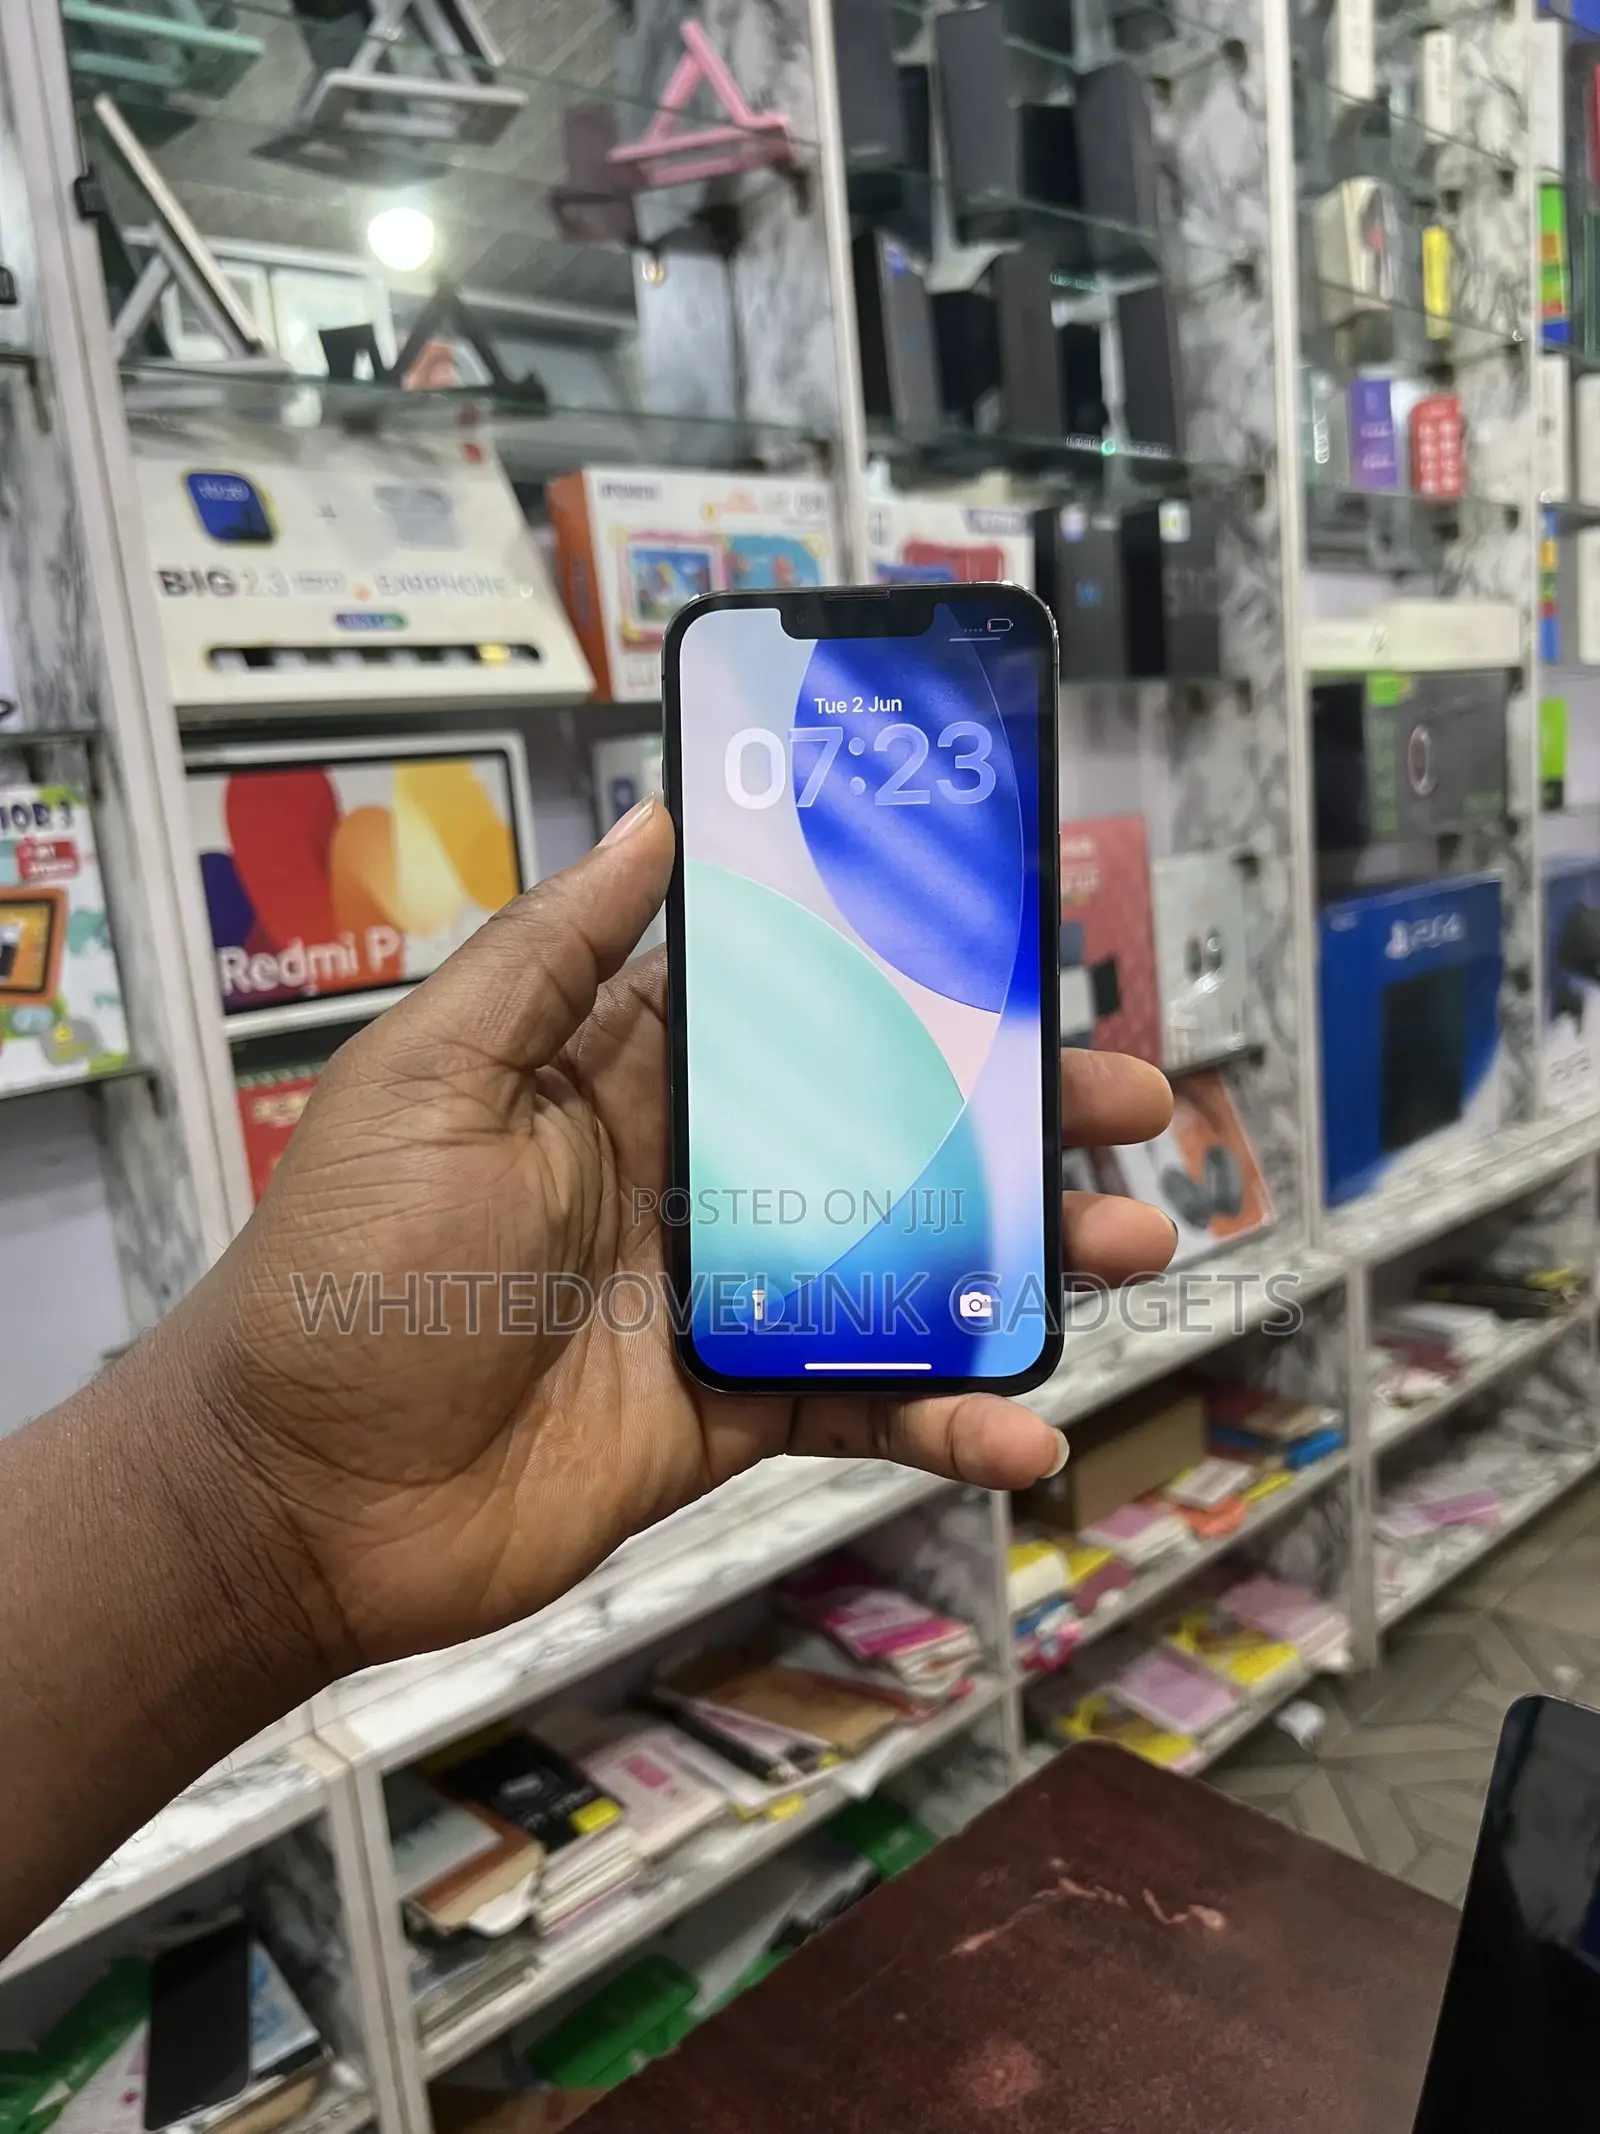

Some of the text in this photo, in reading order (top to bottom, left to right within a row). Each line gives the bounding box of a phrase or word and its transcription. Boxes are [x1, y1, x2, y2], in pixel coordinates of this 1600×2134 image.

[159, 569, 238, 598] BIG
[814, 696, 902, 714] Tue 2 Jun
[724, 720, 997, 810] 07:23
[217, 930, 359, 996] Redmi
